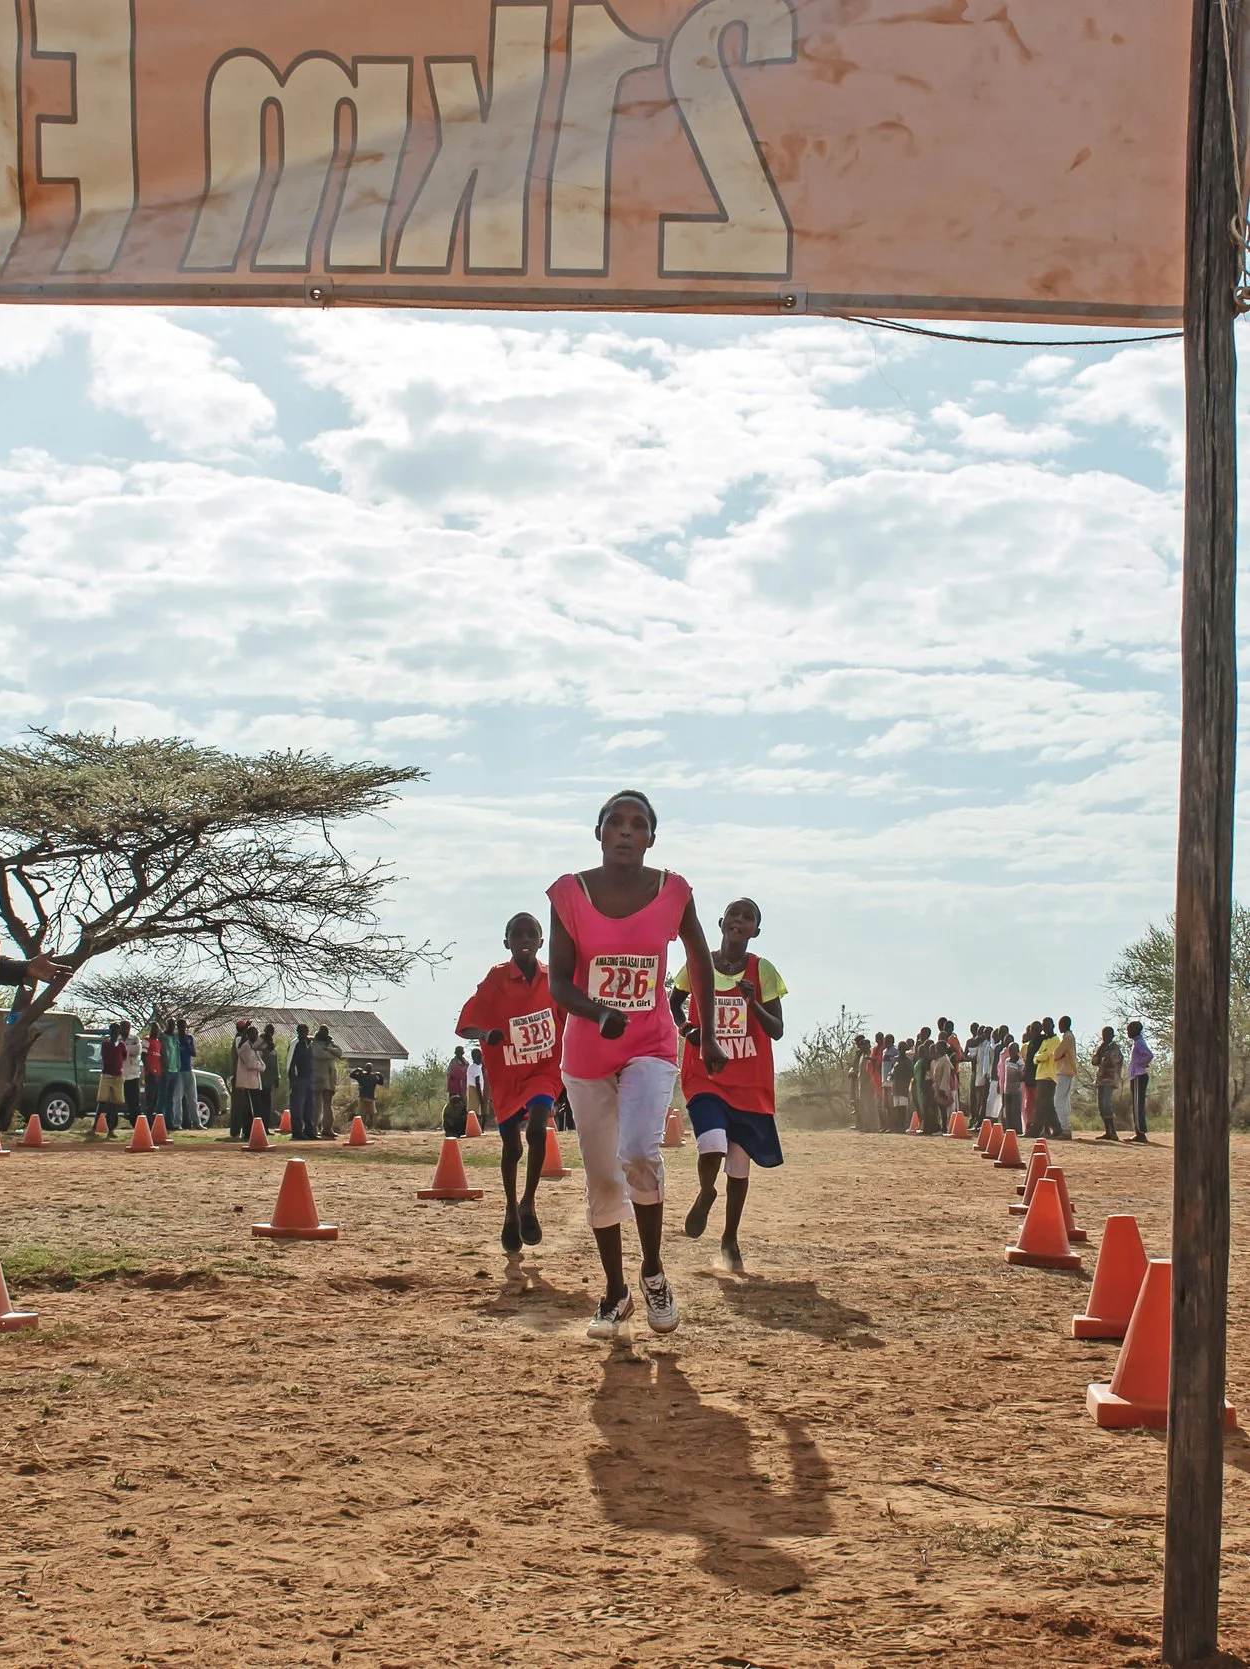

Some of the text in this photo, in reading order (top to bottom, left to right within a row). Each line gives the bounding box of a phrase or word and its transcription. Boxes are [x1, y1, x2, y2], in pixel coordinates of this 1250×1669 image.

[596, 957, 618, 966] AMAZING
[640, 958, 654, 968] ULTRA
[599, 967, 649, 1000] 226
[519, 1019, 551, 1047] 328
[700, 1036, 757, 1059] NYA
